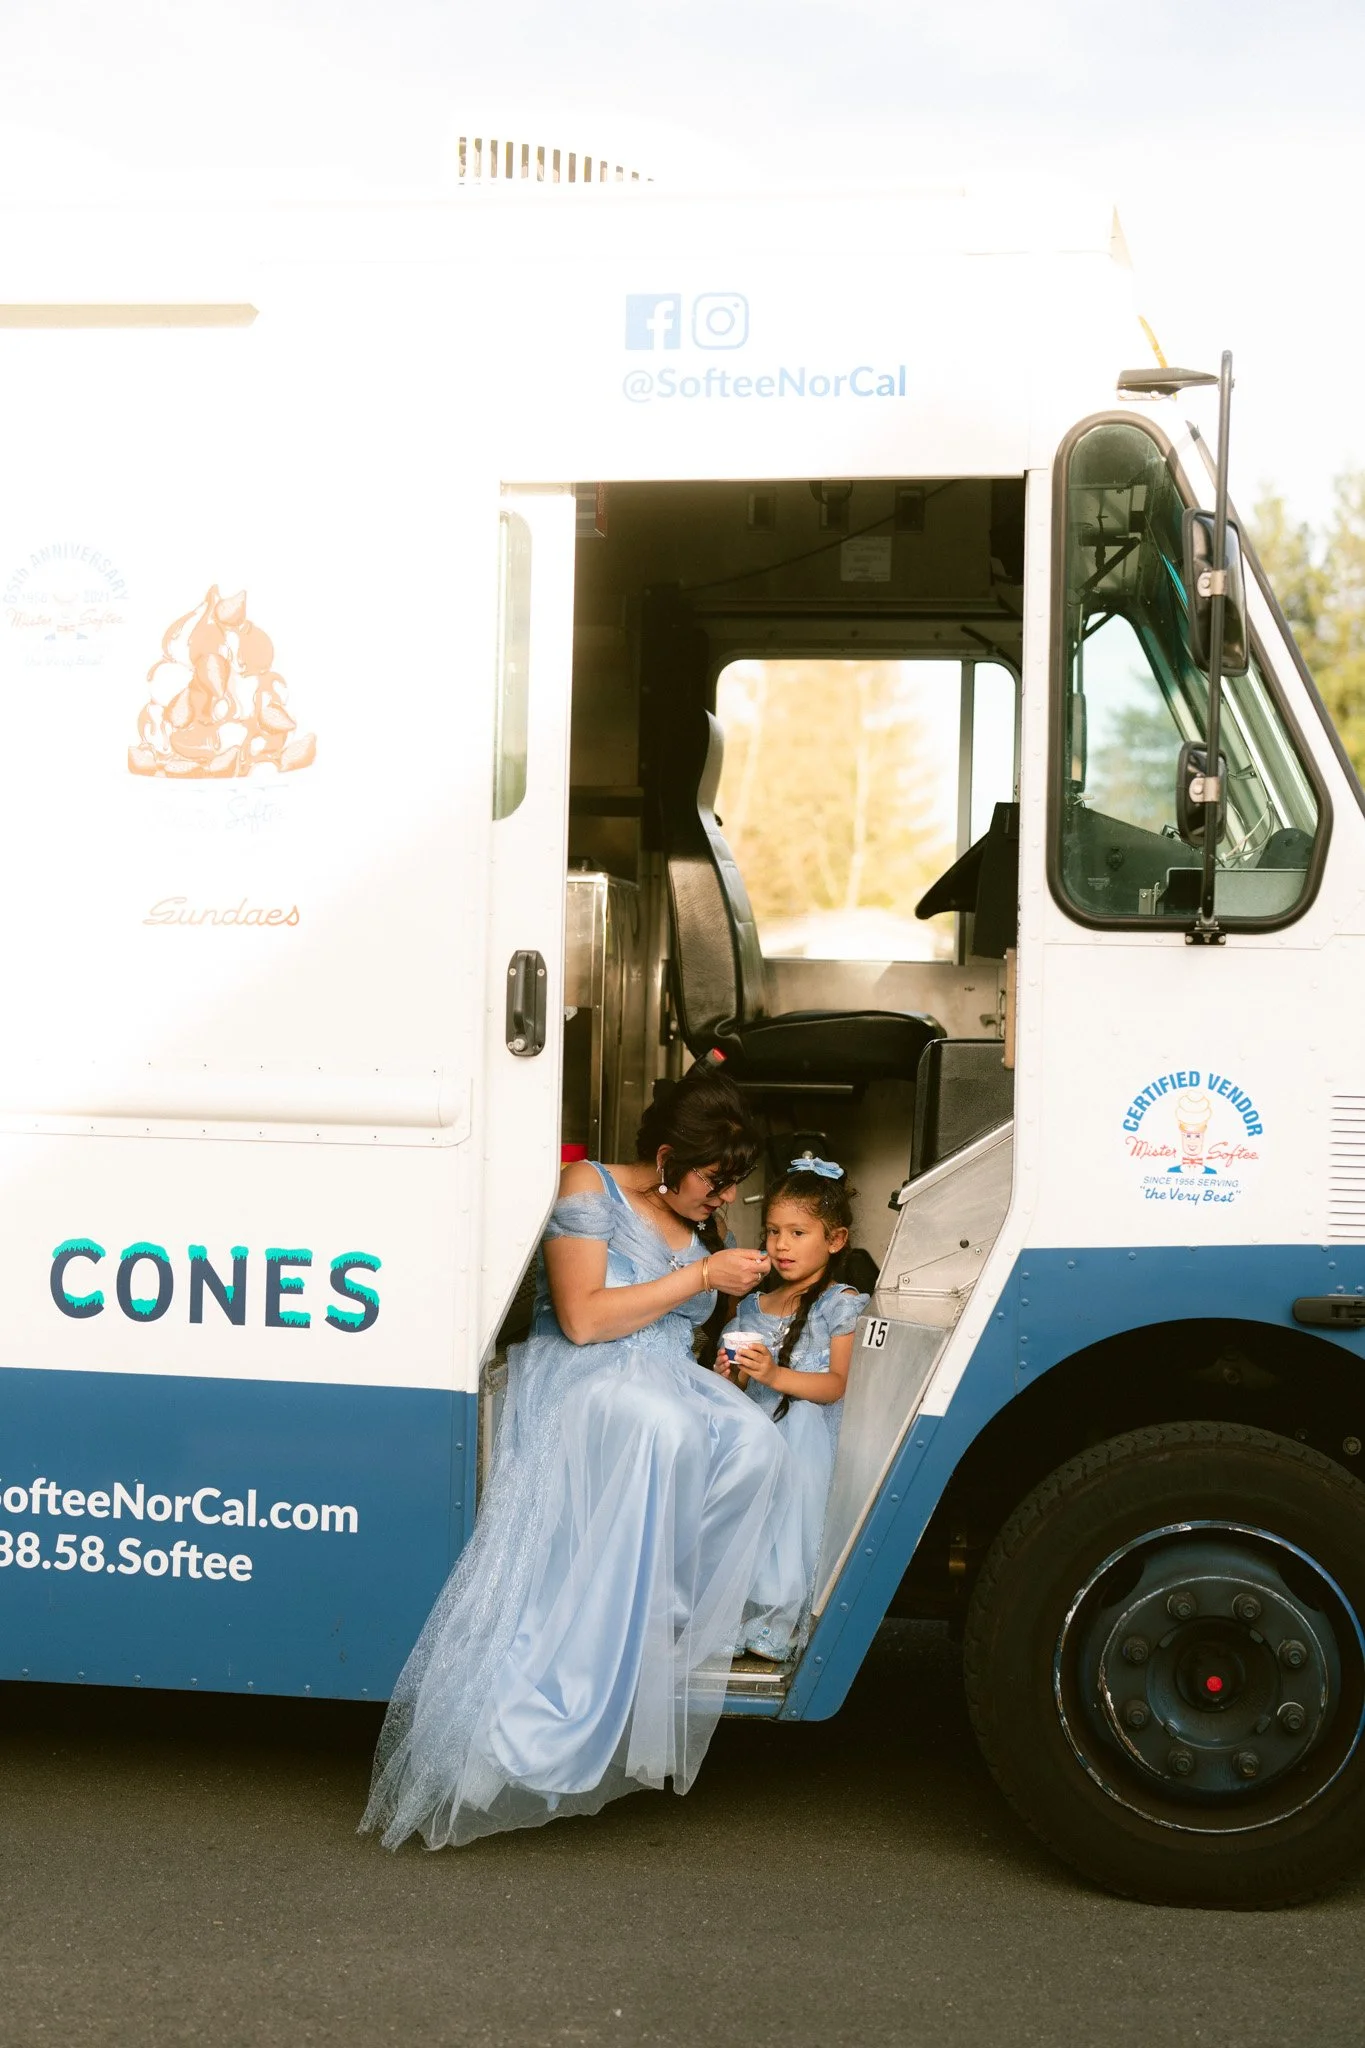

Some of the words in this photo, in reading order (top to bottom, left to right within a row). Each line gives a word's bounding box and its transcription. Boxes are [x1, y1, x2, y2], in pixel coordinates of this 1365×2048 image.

[622, 364, 907, 404] @SofteeNorCal
[29, 540, 131, 600] ANNIVERSARY
[142, 896, 301, 927] Sundaes
[1122, 1070, 1201, 1132] CERTIFIED
[1207, 1072, 1264, 1137] VENDOR
[1125, 1135, 1177, 1160] Mister
[1205, 1141, 1260, 1167] Softee
[1143, 1175, 1173, 1185] SINCE
[1175, 1176, 1196, 1186] 1956
[1197, 1178, 1240, 1188] SERVING
[1168, 1187, 1200, 1205] Very
[50, 1237, 383, 1334] CONES
[867, 1319, 889, 1348] 15
[0, 1476, 360, 1534] ofteeNorCal.com
